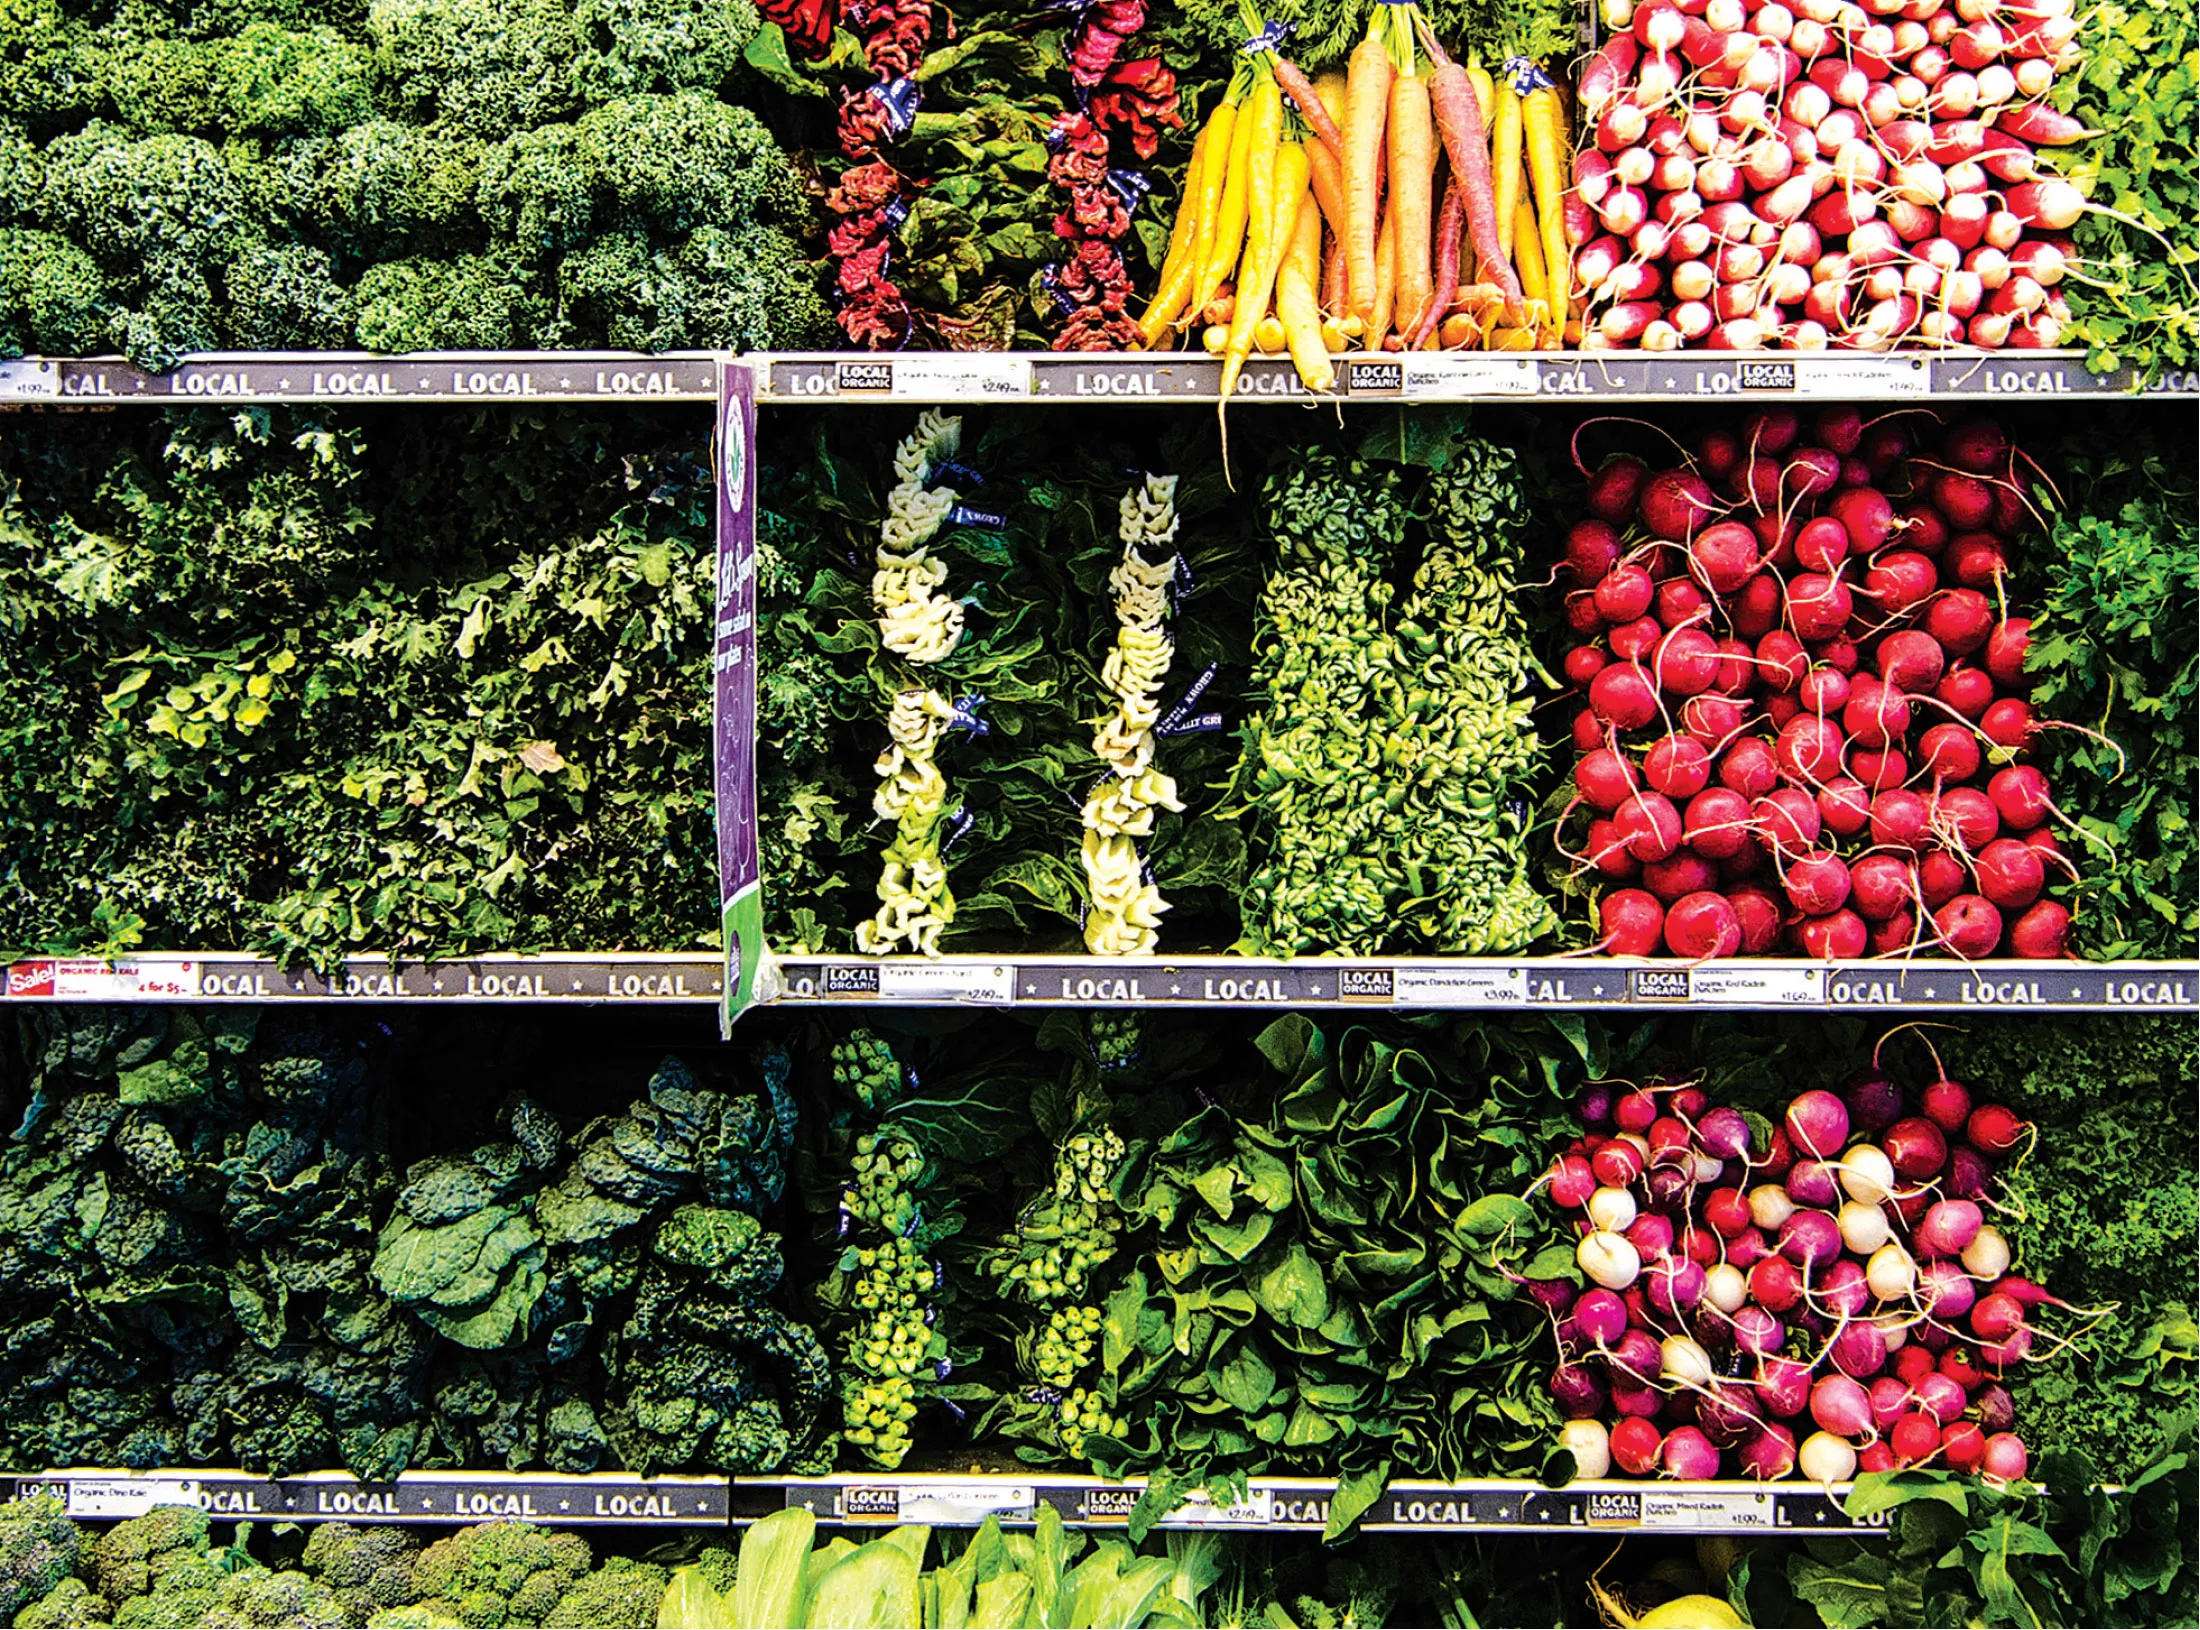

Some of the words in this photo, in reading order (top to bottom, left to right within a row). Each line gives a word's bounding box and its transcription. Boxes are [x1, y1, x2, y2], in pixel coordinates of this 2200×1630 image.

[841, 364, 890, 378] LOCAL
[1351, 364, 1402, 379] LOCAL
[1743, 363, 1793, 377] LOCAL
[59, 374, 113, 396] CAL
[171, 373, 255, 396] LOCAL
[313, 373, 396, 396] LOCAL
[453, 373, 537, 396] LOCAL
[595, 372, 680, 395] LOCAL
[790, 374, 839, 395] LOC
[841, 378, 890, 388] ORGANIC
[1076, 373, 1160, 396] LOCAL
[1234, 373, 1305, 395] OCAL
[1350, 378, 1402, 389] ORGANIC
[1538, 371, 1593, 393] CAL
[1742, 376, 1793, 388] ORGANIC
[1985, 371, 2071, 393] LOCAL
[2132, 371, 2199, 392] LOCA
[1184, 670, 1213, 704] GROWN
[10, 964, 55, 992] Sale!
[60, 967, 98, 976] ORGANIC
[829, 968, 878, 981] LOCAL
[1343, 971, 1392, 985] LOCAL
[1638, 971, 1688, 985] LOCAL
[148, 980, 165, 992] for
[201, 974, 271, 996] OCAL
[328, 974, 411, 997] LOCAL
[466, 974, 549, 996] LOCAL
[607, 975, 691, 997] LOCAL
[829, 980, 878, 992] ORGANIC
[1061, 979, 1146, 1001] LOCAL
[1204, 979, 1288, 1001] LOCAL
[1343, 984, 1392, 995] ORGANIC
[1527, 979, 1573, 1001] CAL
[1637, 984, 1688, 997] ORGANIC
[1832, 981, 1902, 1004] OCAL
[1961, 981, 2046, 1004] LOCAL
[2106, 981, 2191, 1004] LOCAL
[73, 1488, 107, 1499] Organic
[109, 1488, 129, 1497] Dino
[849, 1490, 896, 1504] LOCAL
[1090, 1492, 1137, 1505] LOCAL
[199, 1491, 261, 1513] OCAL
[318, 1492, 399, 1514] LOCAL
[455, 1493, 537, 1516] LOCAL
[594, 1494, 677, 1517] LOCAL
[848, 1503, 897, 1513] ORGANIC
[1591, 1494, 1639, 1508] LOCAL
[1090, 1504, 1132, 1514] ORGANI
[1272, 1500, 1329, 1522] OCAL
[1393, 1502, 1476, 1525] LOCAL
[1590, 1507, 1639, 1518] ORGANIC
